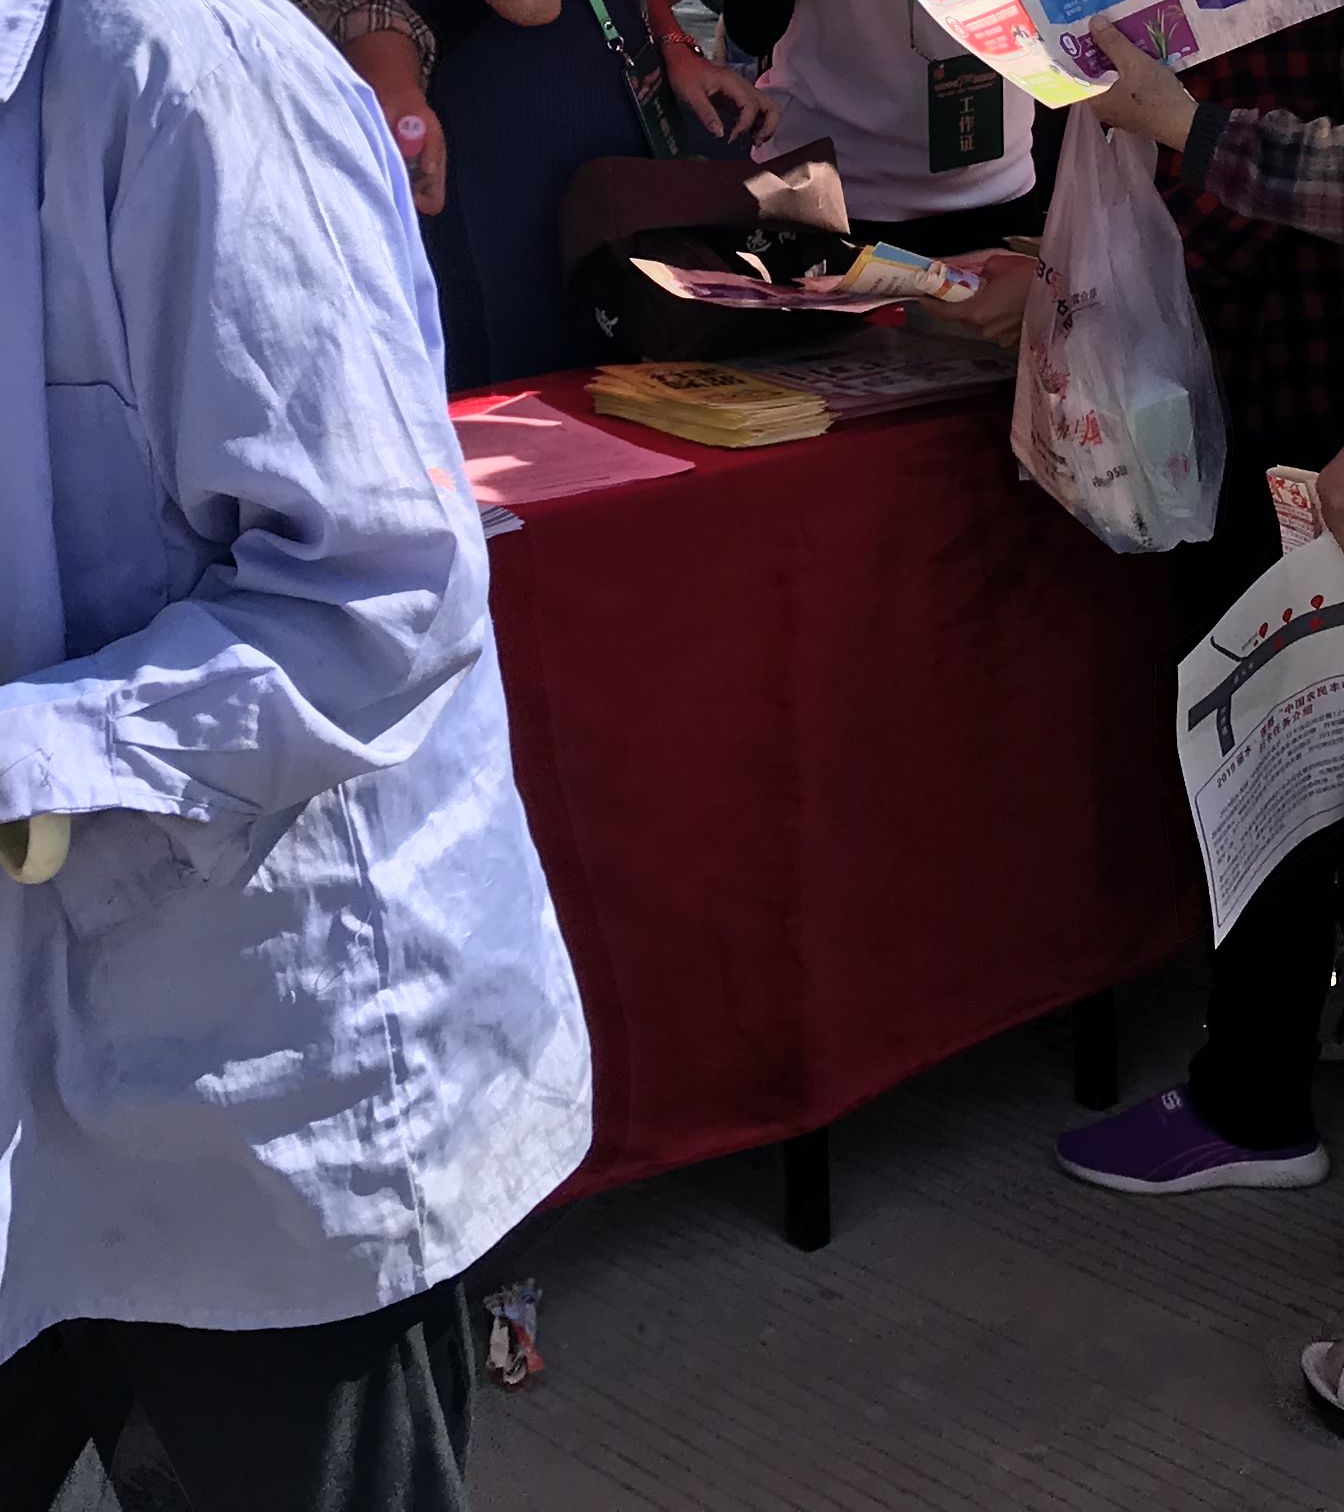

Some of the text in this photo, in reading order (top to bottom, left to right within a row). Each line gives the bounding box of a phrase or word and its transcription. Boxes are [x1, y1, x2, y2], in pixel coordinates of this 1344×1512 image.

[1061, 34, 1077, 55] 9
[959, 96, 975, 151] 工作证
